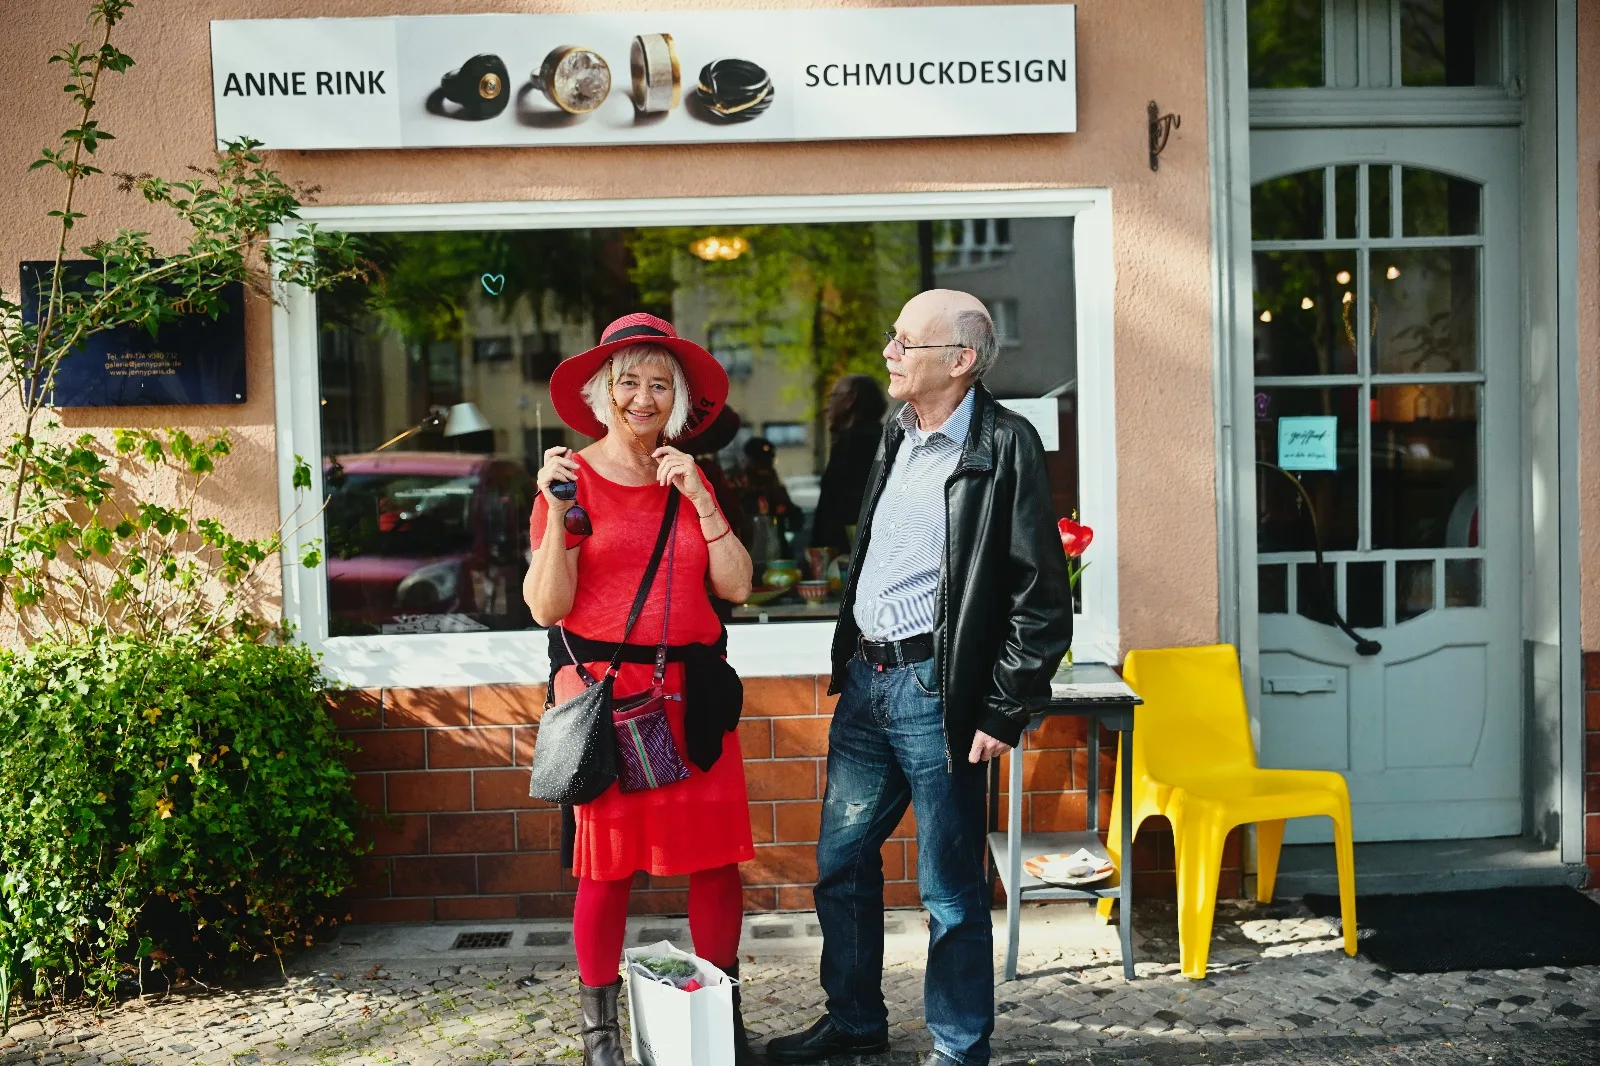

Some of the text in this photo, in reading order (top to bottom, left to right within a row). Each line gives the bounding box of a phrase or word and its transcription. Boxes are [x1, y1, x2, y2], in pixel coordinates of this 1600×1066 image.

[223, 70, 386, 97] ANNE RINK
[805, 59, 1067, 87] SCHMUCKDESIGN
[109, 368, 176, 377] www.jennyparis.de
